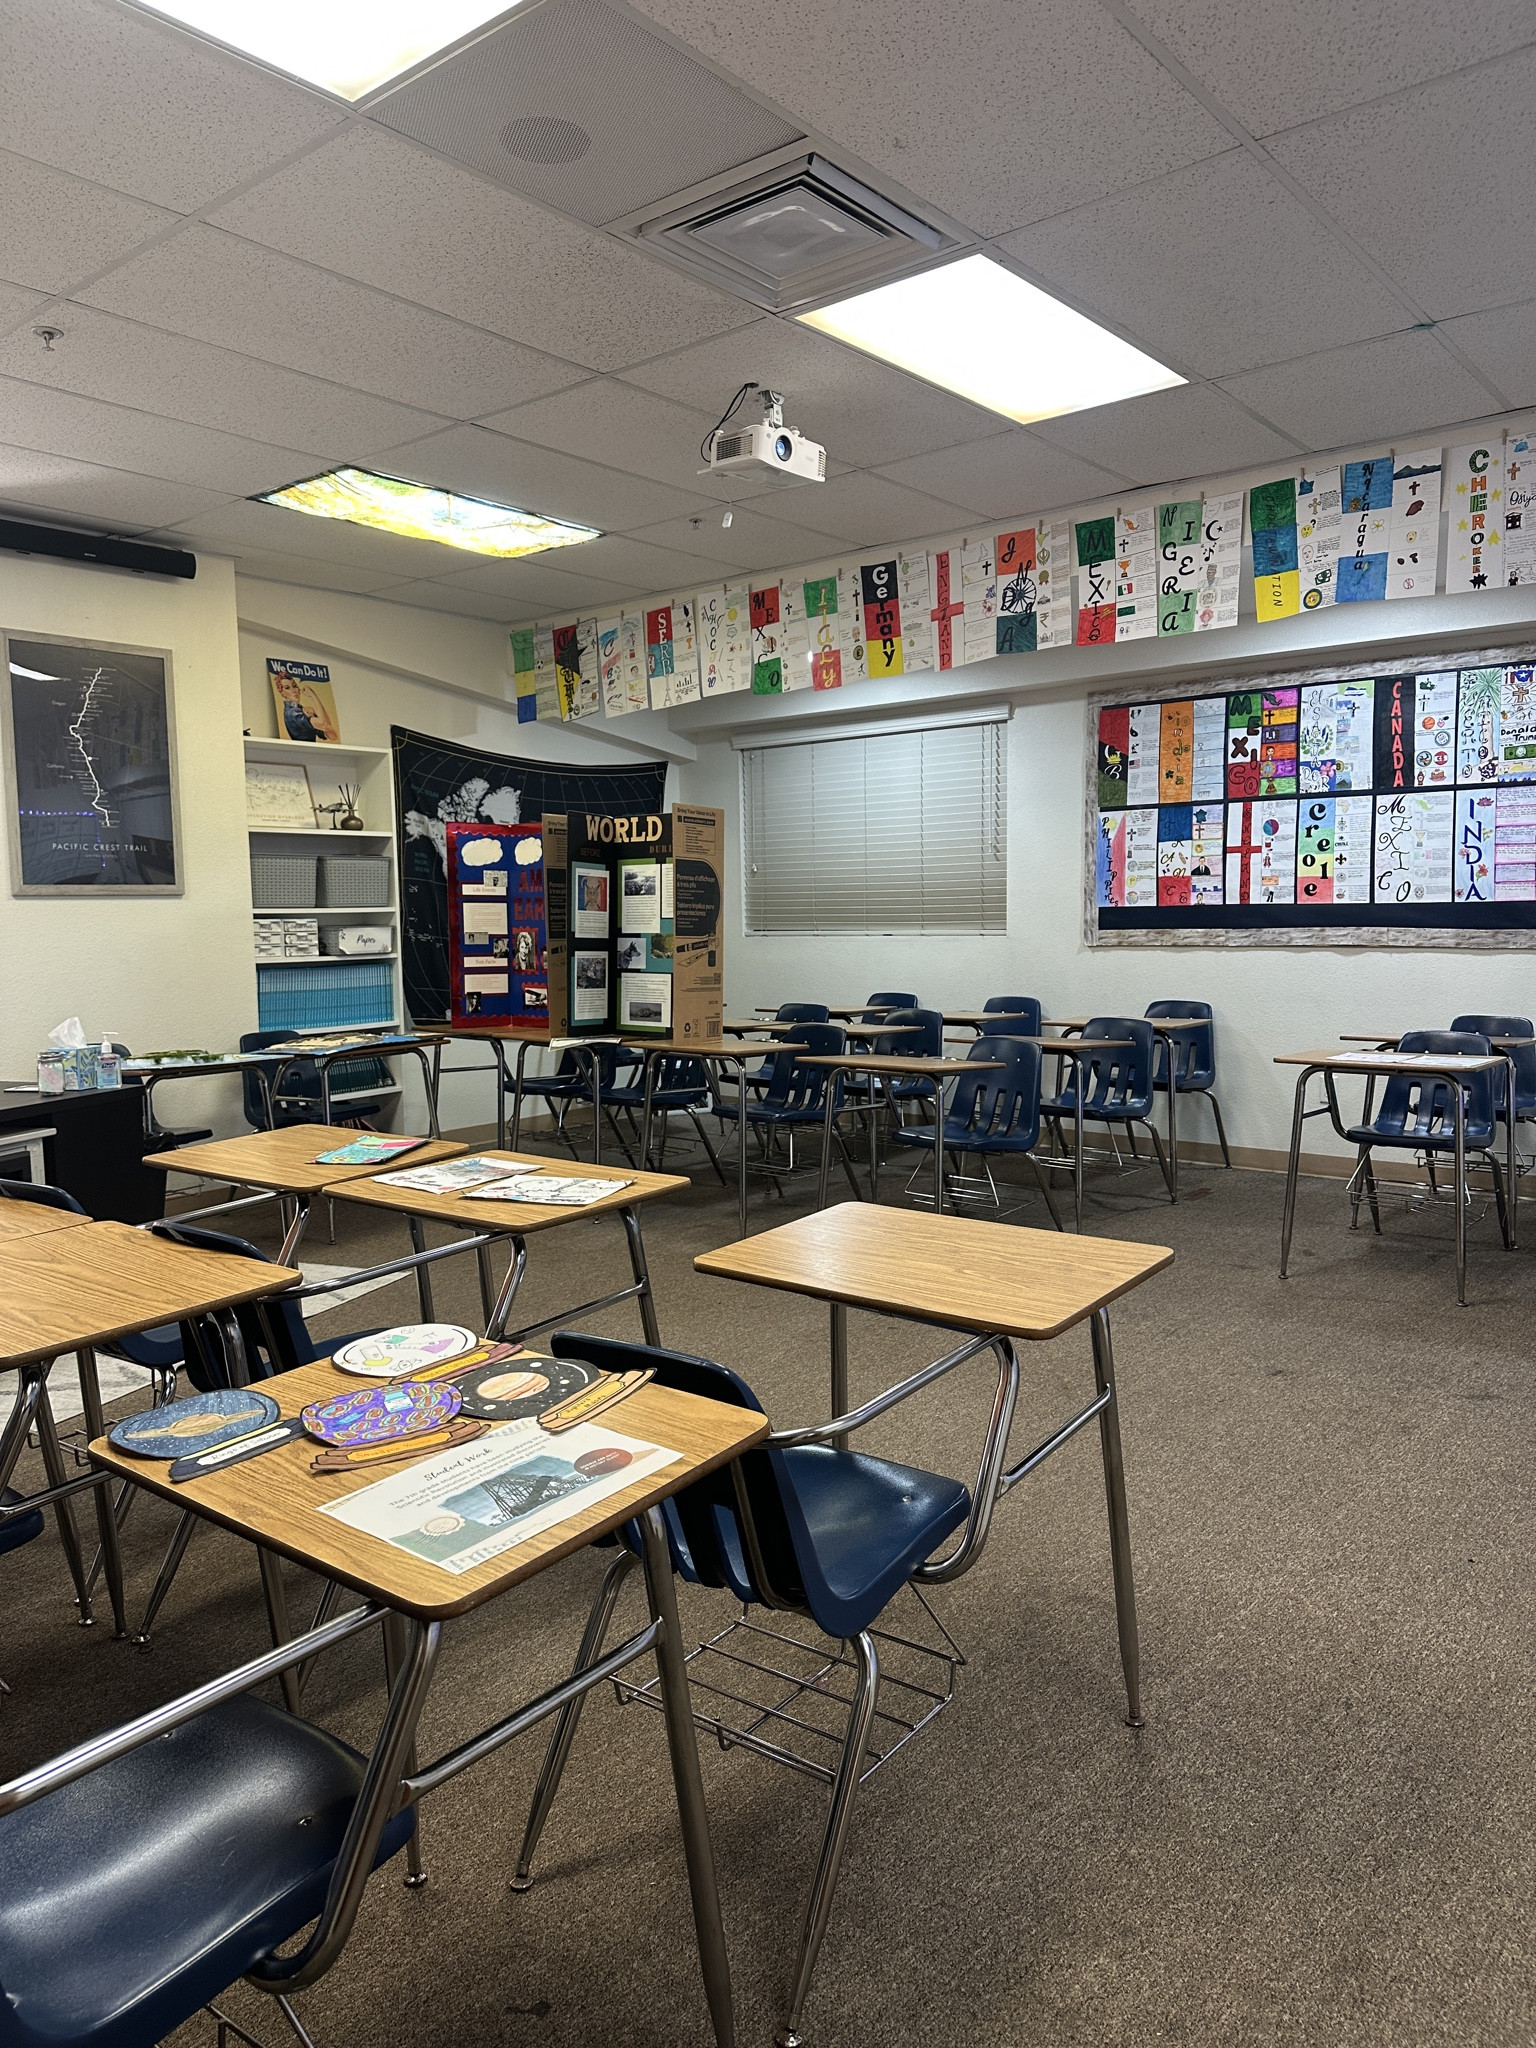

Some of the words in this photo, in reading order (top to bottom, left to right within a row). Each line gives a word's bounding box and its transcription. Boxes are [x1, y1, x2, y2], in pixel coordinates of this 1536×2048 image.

[1354, 463, 1374, 571] Nicaragua
[1469, 449, 1490, 574] CHEROKEE
[872, 566, 896, 667] Germany
[940, 554, 951, 666] ENGLAND
[1086, 529, 1106, 641] MEXICO
[270, 660, 287, 673] We
[286, 662, 304, 675] Can
[303, 664, 317, 677] Do
[316, 666, 328, 679] It!
[752, 592, 780, 687] MEXICO
[1229, 694, 1262, 795] MEXICO
[1391, 681, 1404, 787] CANADA
[52, 842, 89, 851] PACIFIC
[93, 843, 120, 851] CREST
[124, 844, 148, 852] TRAIL
[586, 815, 663, 843] WORLD
[1377, 795, 1413, 902] MEXICO
[1461, 798, 1488, 901] INDIA
[419, 1483, 440, 1493] grade
[441, 1469, 470, 1483] students
[424, 1460, 464, 1481] Student
[464, 1448, 493, 1463] Work
